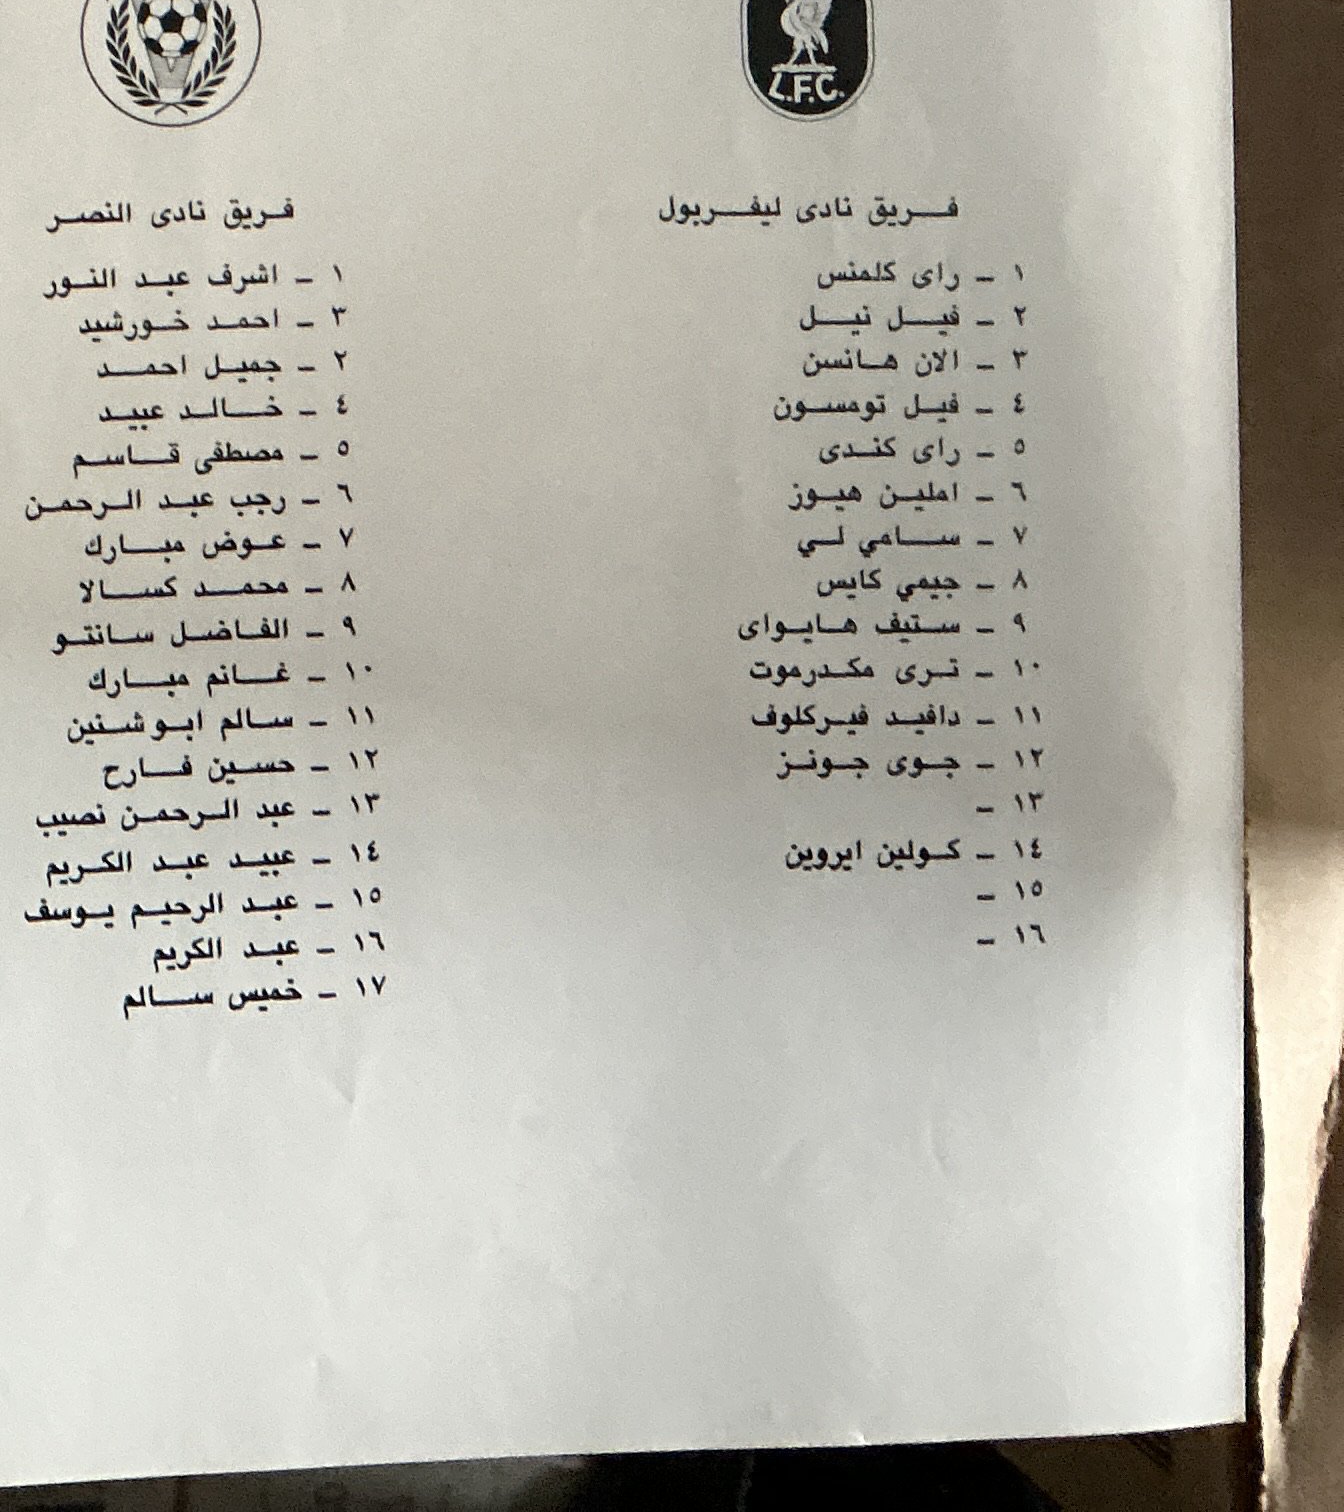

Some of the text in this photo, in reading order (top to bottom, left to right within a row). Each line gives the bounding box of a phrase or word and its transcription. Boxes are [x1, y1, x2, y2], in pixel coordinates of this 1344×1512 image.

[45, 201, 132, 234] النصر
[223, 197, 295, 230] فريق
[658, 195, 782, 227] ليفربول
[867, 196, 959, 228] فريق
[42, 267, 117, 300] النور
[134, 270, 190, 298] عبد
[817, 260, 897, 290] كلمنس
[206, 307, 279, 331] احمد
[799, 304, 960, 337] فيل نيل
[96, 353, 282, 384] جميل احمد
[802, 348, 959, 378] الان هانسن
[98, 395, 284, 432] خالد عبيد
[773, 392, 960, 424] فيل تومسون
[72, 441, 285, 480] مصطفى قاسم
[24, 488, 287, 522] رجب عبد الرحمن
[787, 482, 863, 512] هيوز
[84, 530, 286, 566] عوض مبارك
[193, 581, 289, 598] محمد
[170, 616, 289, 649] الفاضل
[874, 611, 961, 644] ستيف
[88, 661, 291, 700] غانم مبارك
[749, 656, 875, 689] مكدرموت
[220, 706, 294, 742] سالم
[750, 703, 961, 736] دافيد فيركلوف
[207, 757, 296, 786] حسين
[776, 748, 870, 781] جونز
[120, 797, 239, 833] الرحمن
[256, 801, 296, 829] عبد
[46, 849, 296, 888] عبيد عبد الكريم
[785, 838, 961, 872] كولين ايروين
[23, 891, 299, 930] عبد الرحيم يوسف
[152, 936, 300, 974] عبد الكريم
[122, 978, 303, 1021] خميس سالم
